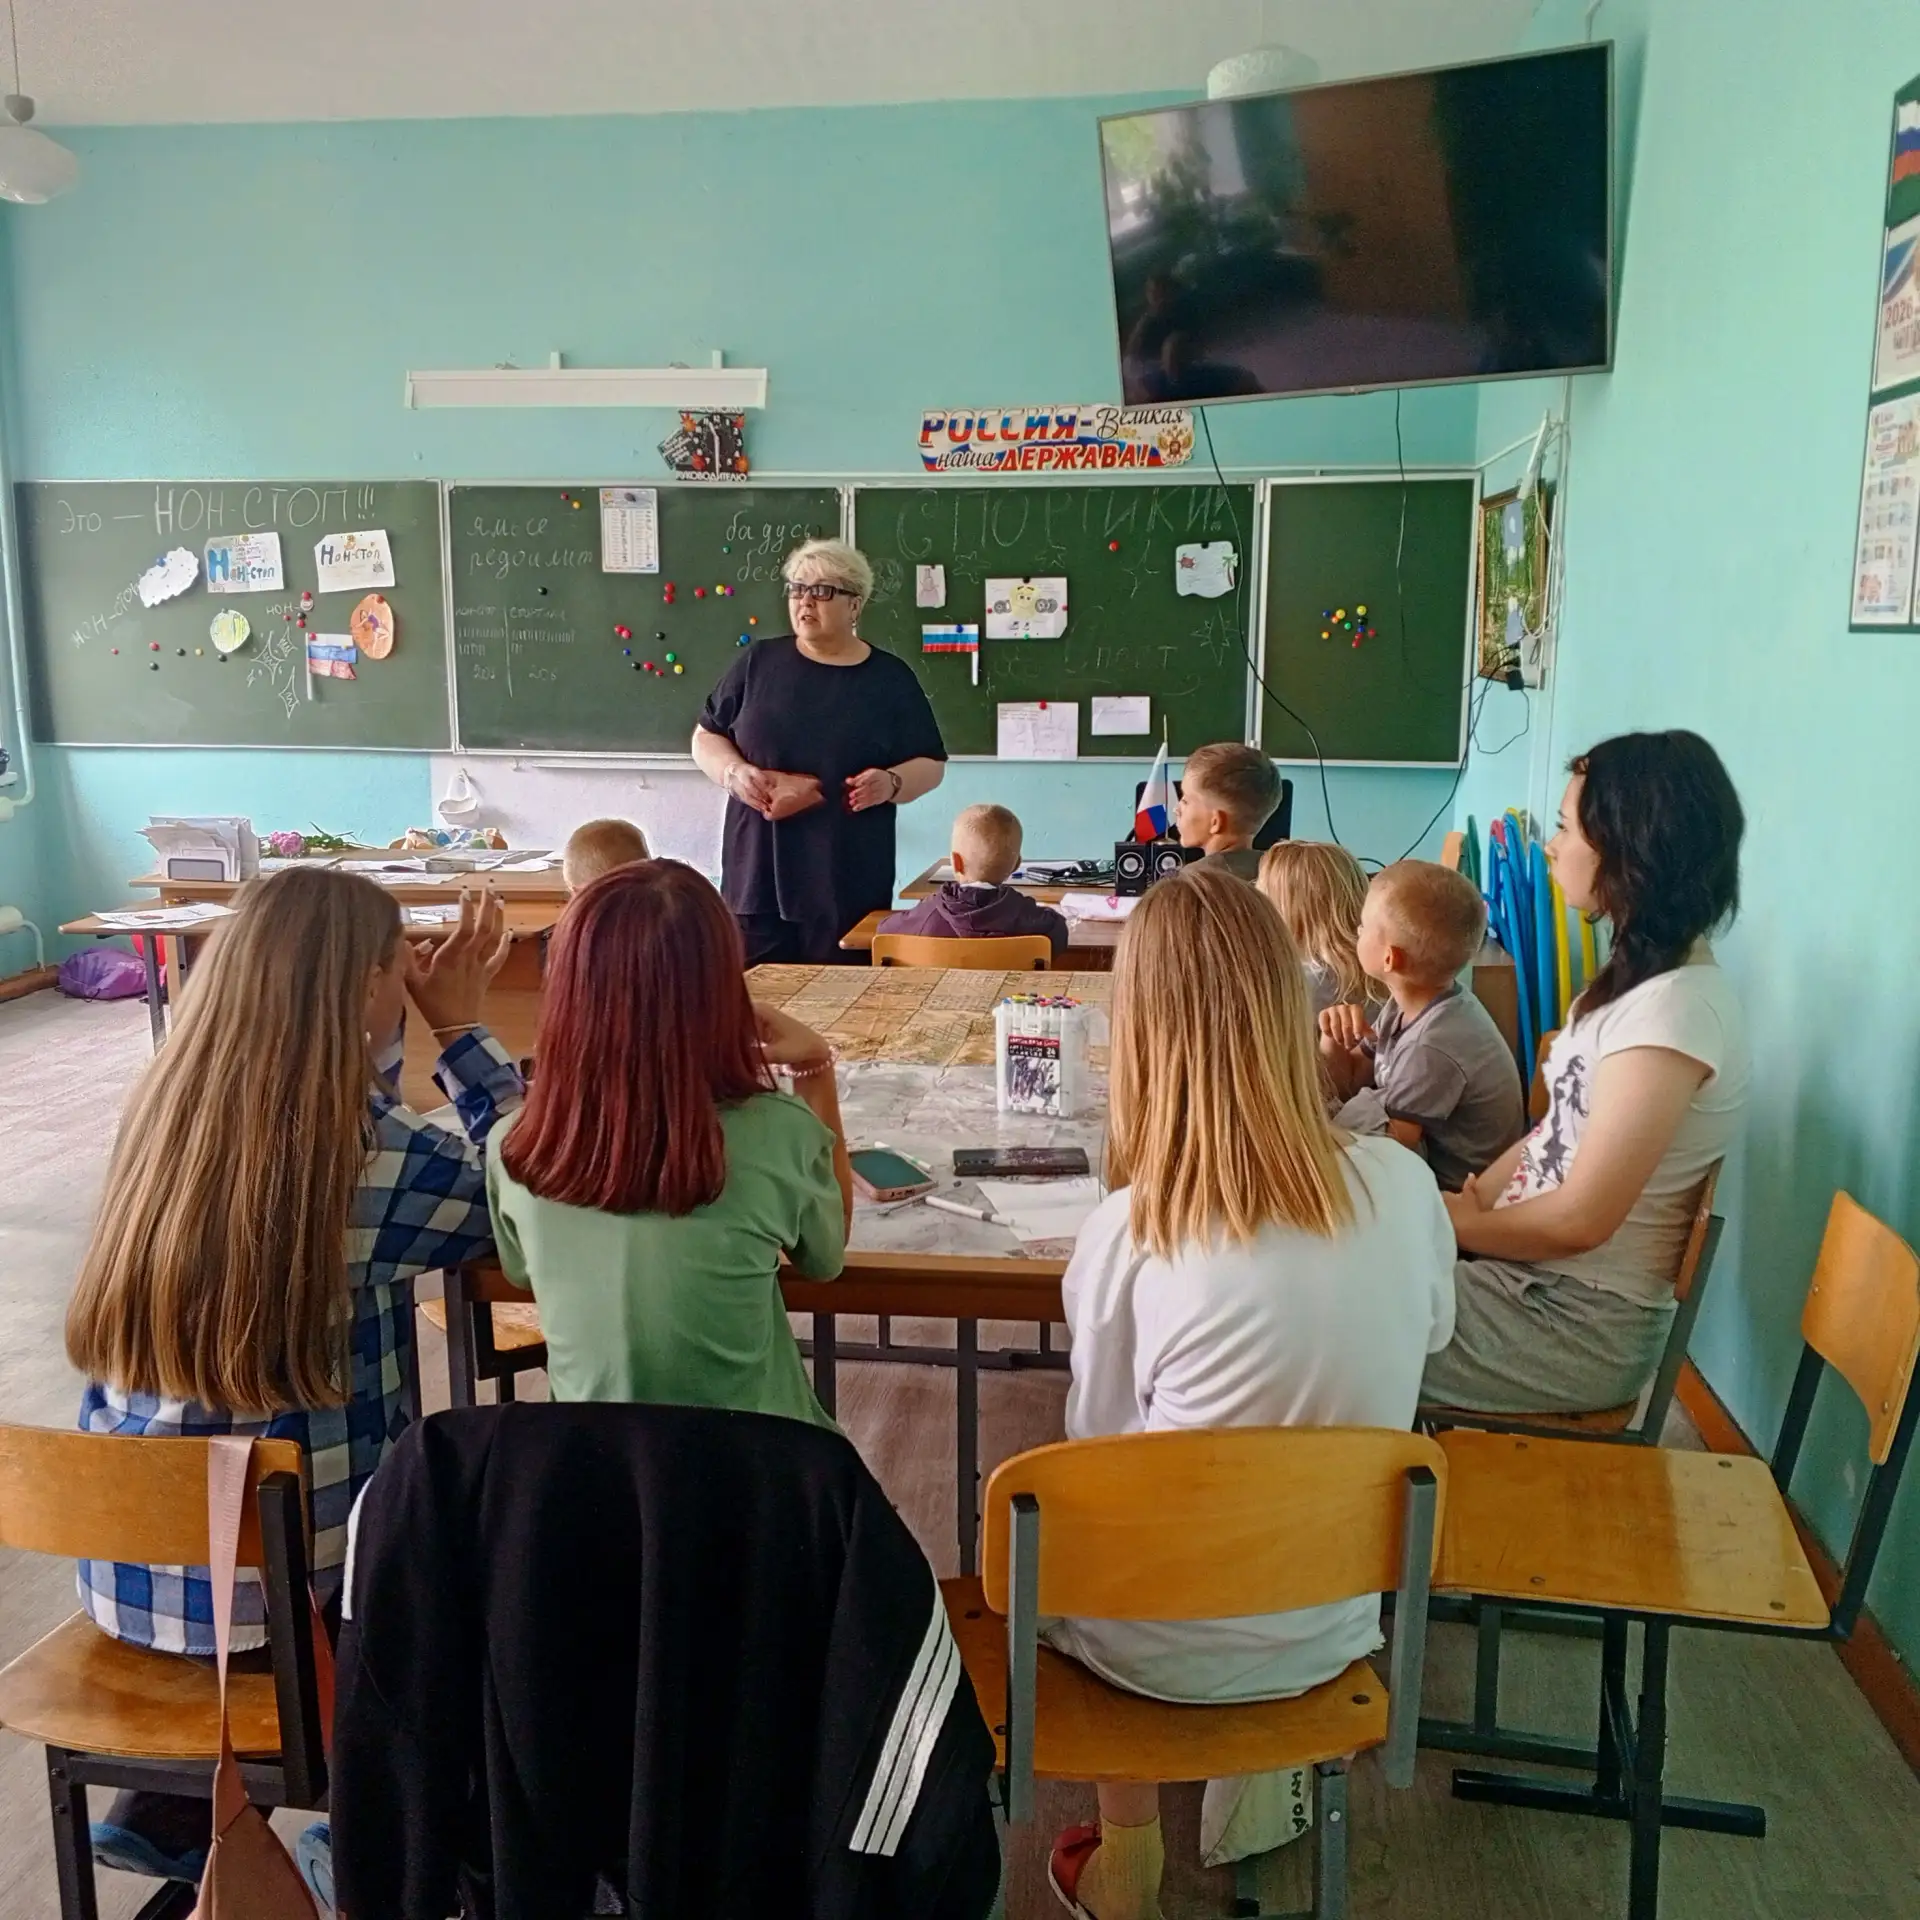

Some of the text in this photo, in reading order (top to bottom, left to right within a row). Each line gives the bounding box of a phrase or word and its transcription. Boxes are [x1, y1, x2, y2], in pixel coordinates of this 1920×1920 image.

[1095, 407, 1185, 440] Великая
[936, 443, 1149, 471] наша ДЕРЖАВА!
